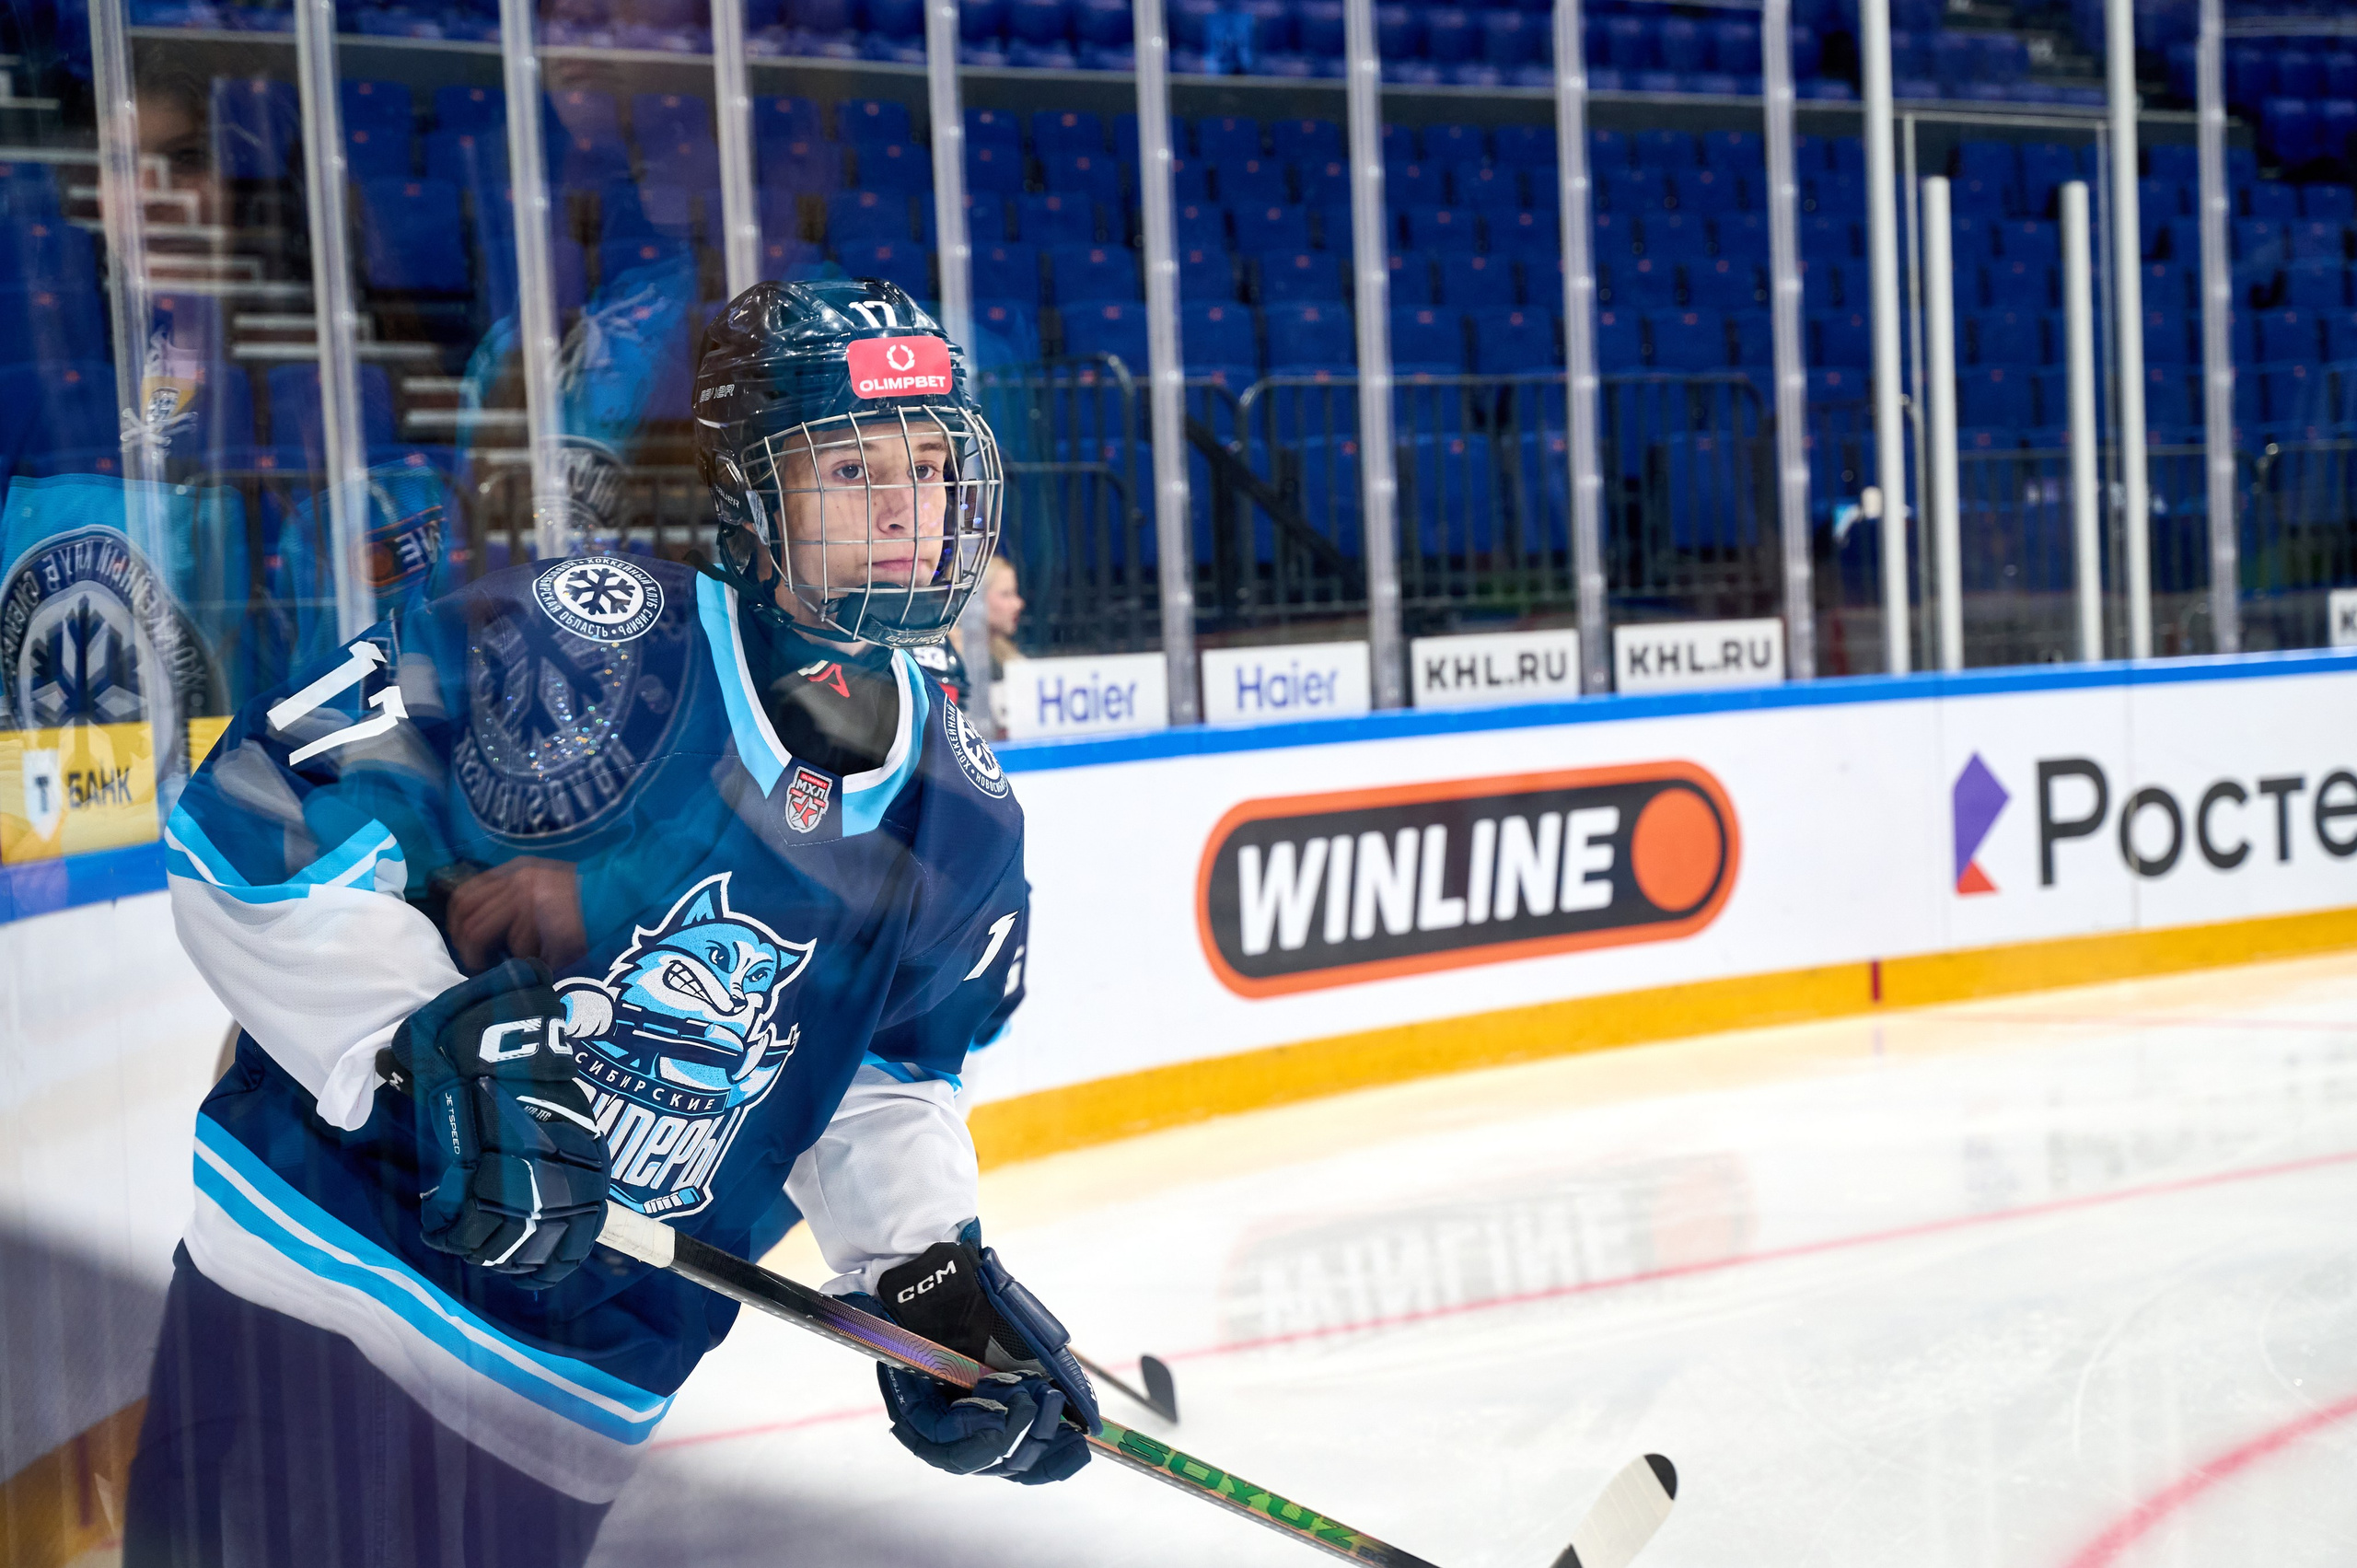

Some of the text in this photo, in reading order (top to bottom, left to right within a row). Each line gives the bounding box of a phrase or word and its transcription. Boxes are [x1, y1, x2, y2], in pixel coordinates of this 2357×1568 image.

[848, 300, 898, 329] 17
[859, 376, 946, 392] OLIMPBET
[586, 558, 654, 586] ХОККЕЙНЫЙ
[644, 586, 659, 610] КЛУБ
[559, 610, 609, 638] ОБЛАСТЬ
[618, 608, 654, 636] СИБИРЬ
[1424, 648, 1567, 691] KHL.RU
[1628, 637, 1771, 677] KHL.RU
[267, 641, 409, 766] 17
[1037, 668, 1137, 726] Haier
[1234, 660, 1339, 711] Haier
[946, 703, 972, 771] ХОККЕЙНЫЙ
[67, 766, 133, 809] БАНК
[796, 779, 826, 799] МХЛ
[2035, 757, 2357, 888] Росте
[1237, 805, 1620, 958] WINLINE
[575, 1051, 715, 1109] СИБИРСКИЕ
[445, 1092, 460, 1155] JETSPEED
[571, 1077, 741, 1192] ЙПЕРЫ
[897, 1260, 958, 1304] CCM
[1117, 1429, 1357, 1552] SOYUZ
